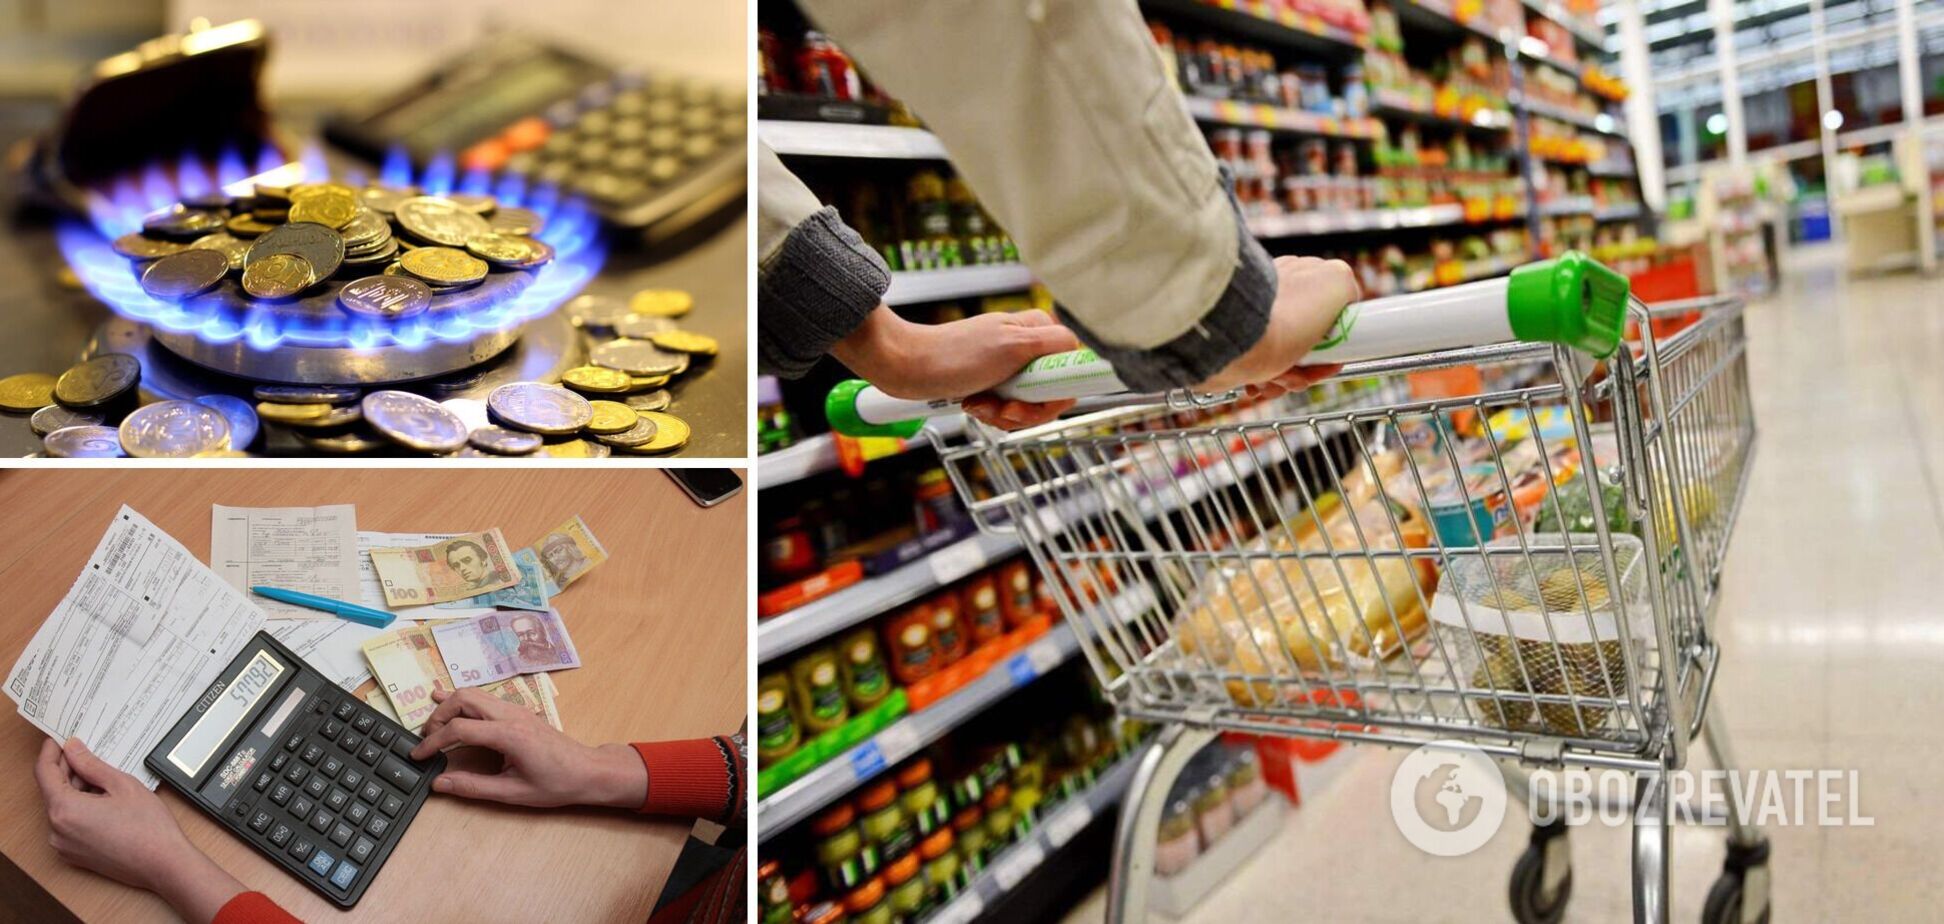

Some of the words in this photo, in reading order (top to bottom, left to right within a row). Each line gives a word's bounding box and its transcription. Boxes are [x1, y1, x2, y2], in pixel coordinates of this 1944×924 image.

[390, 587, 418, 600] 100
[461, 669, 480, 682] 50
[196, 680, 226, 714] CITIZEN
[395, 684, 427, 707] 100
[339, 703, 352, 717] MU
[305, 747, 318, 761] M+
[326, 761, 337, 771] 9
[346, 774, 357, 784] 6
[311, 782, 322, 791] 8
[274, 785, 288, 801] MR
[366, 788, 378, 797] 3
[331, 794, 343, 804] 5
[295, 802, 306, 812] 7
[352, 808, 362, 818] 2
[253, 812, 269, 828] MC
[319, 815, 328, 825] 4
[338, 830, 347, 838] 1
[356, 844, 368, 855] 0
